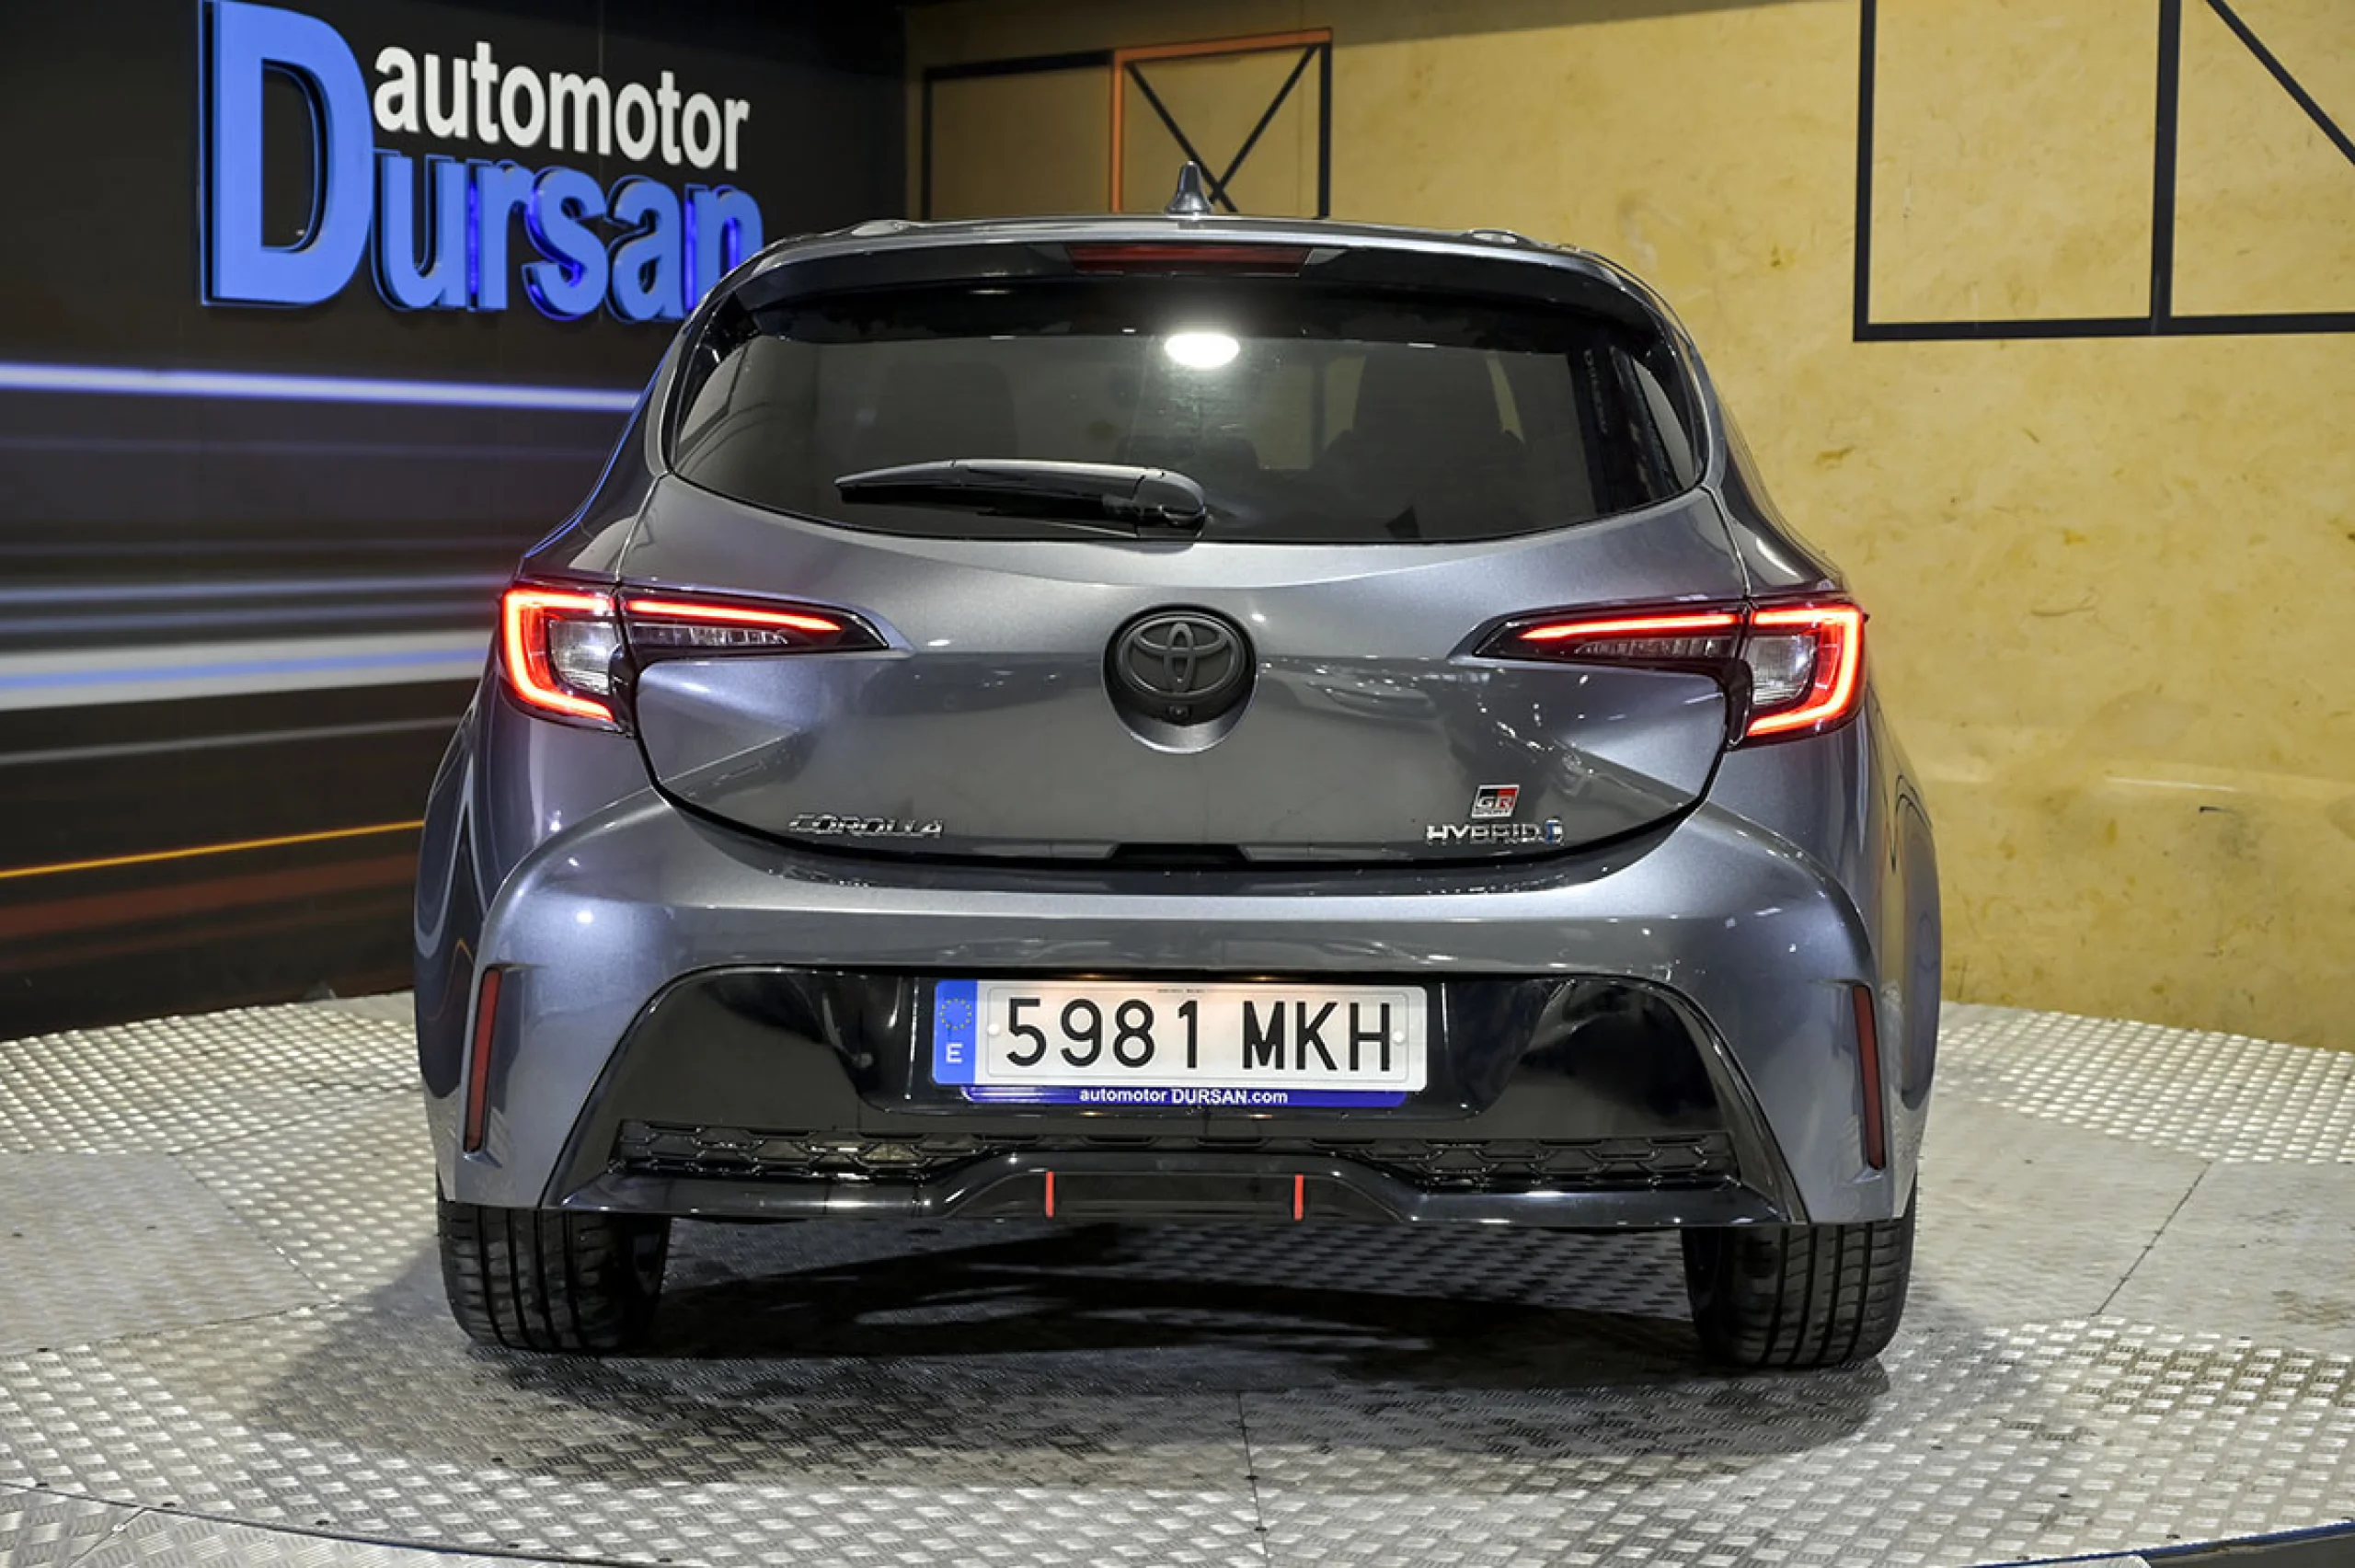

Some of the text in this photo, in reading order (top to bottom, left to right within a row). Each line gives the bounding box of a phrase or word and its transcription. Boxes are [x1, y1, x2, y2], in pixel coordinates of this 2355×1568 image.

[373, 41, 751, 172] automotor
[199, 0, 764, 323] Dursan
[787, 813, 945, 838] COROLLA
[1427, 823, 1541, 846] HYBRID
[1005, 997, 1392, 1072] 5981 MKH
[946, 1042, 963, 1064] E
[1079, 1088, 1289, 1104] automotor DURSAN.com
